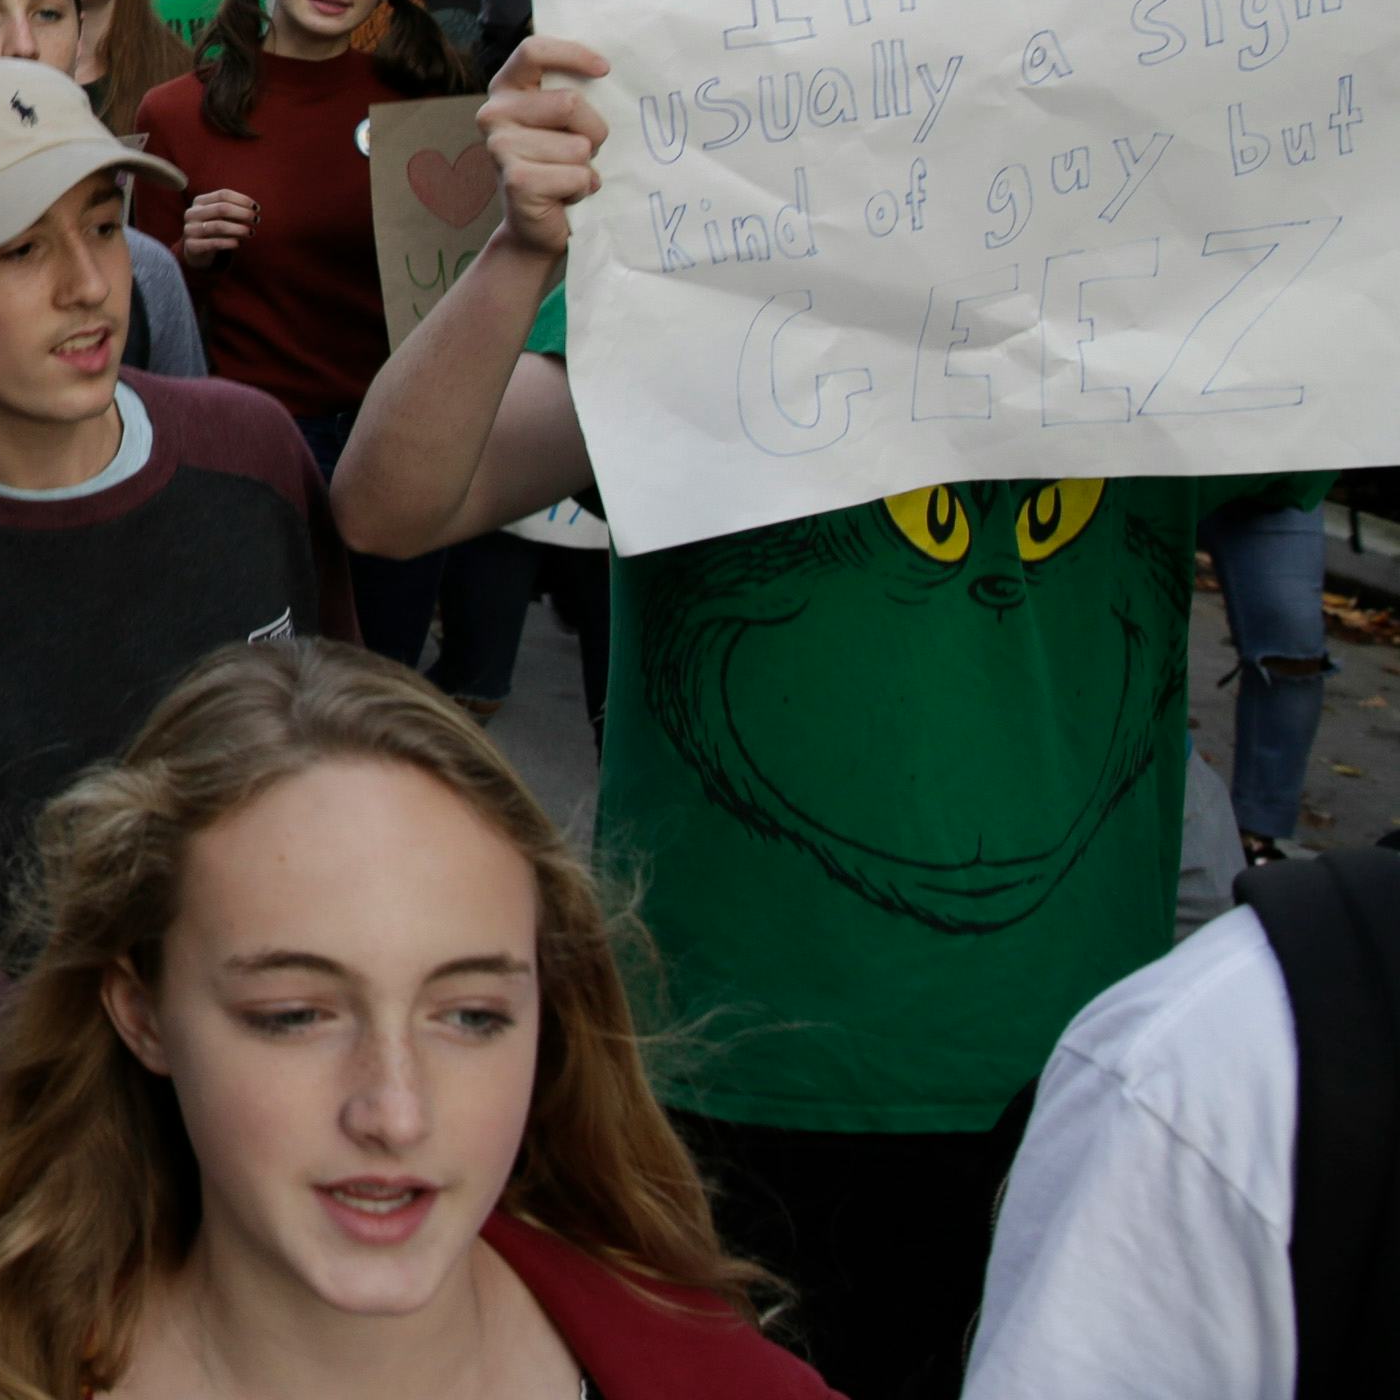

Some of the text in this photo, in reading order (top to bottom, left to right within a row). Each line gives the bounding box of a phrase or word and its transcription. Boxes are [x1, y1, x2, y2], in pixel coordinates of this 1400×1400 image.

[639, 38, 964, 165] usually
[1021, 29, 1074, 86] a
[864, 156, 928, 237] of
[985, 132, 1175, 249] guy
[1227, 73, 1364, 177] but
[736, 215, 1343, 457] GEEZ
